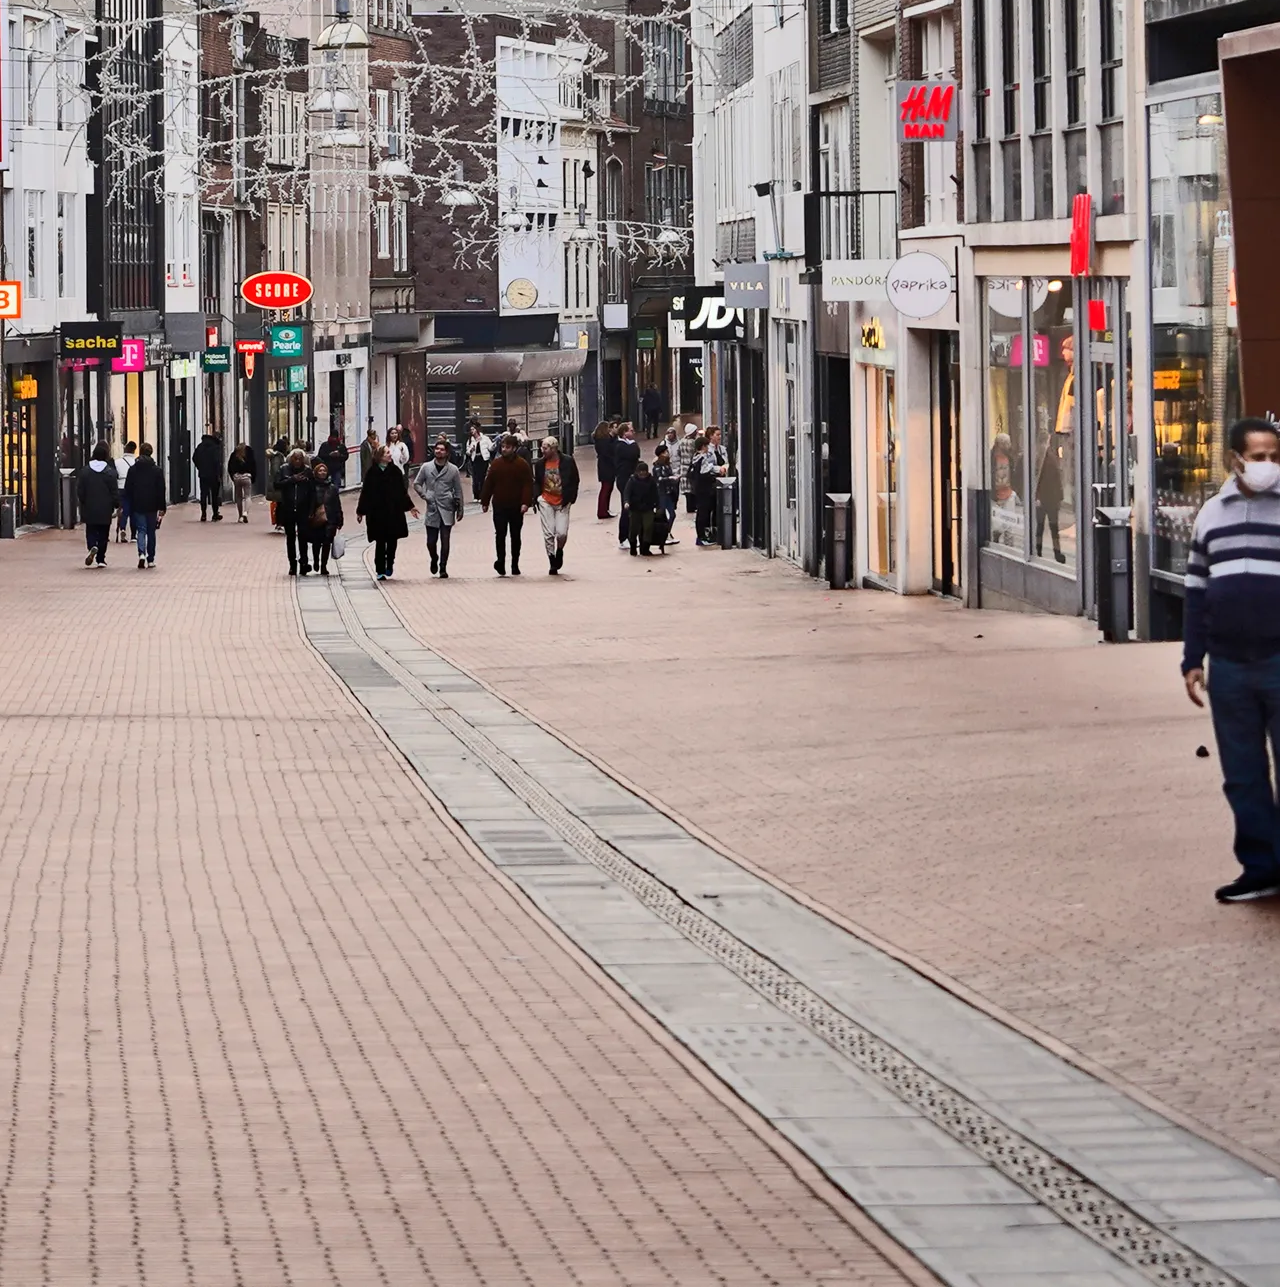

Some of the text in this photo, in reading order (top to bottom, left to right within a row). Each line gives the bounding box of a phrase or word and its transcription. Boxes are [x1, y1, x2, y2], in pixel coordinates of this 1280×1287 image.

[900, 85, 954, 122] H&M
[904, 123, 945, 138] MAN
[256, 283, 299, 298] SCORE
[729, 282, 763, 290] VILA
[891, 279, 948, 293] paprika
[689, 297, 735, 330] JD
[65, 335, 117, 349] sacha
[272, 340, 301, 350] Pearle
[122, 344, 138, 366] T
